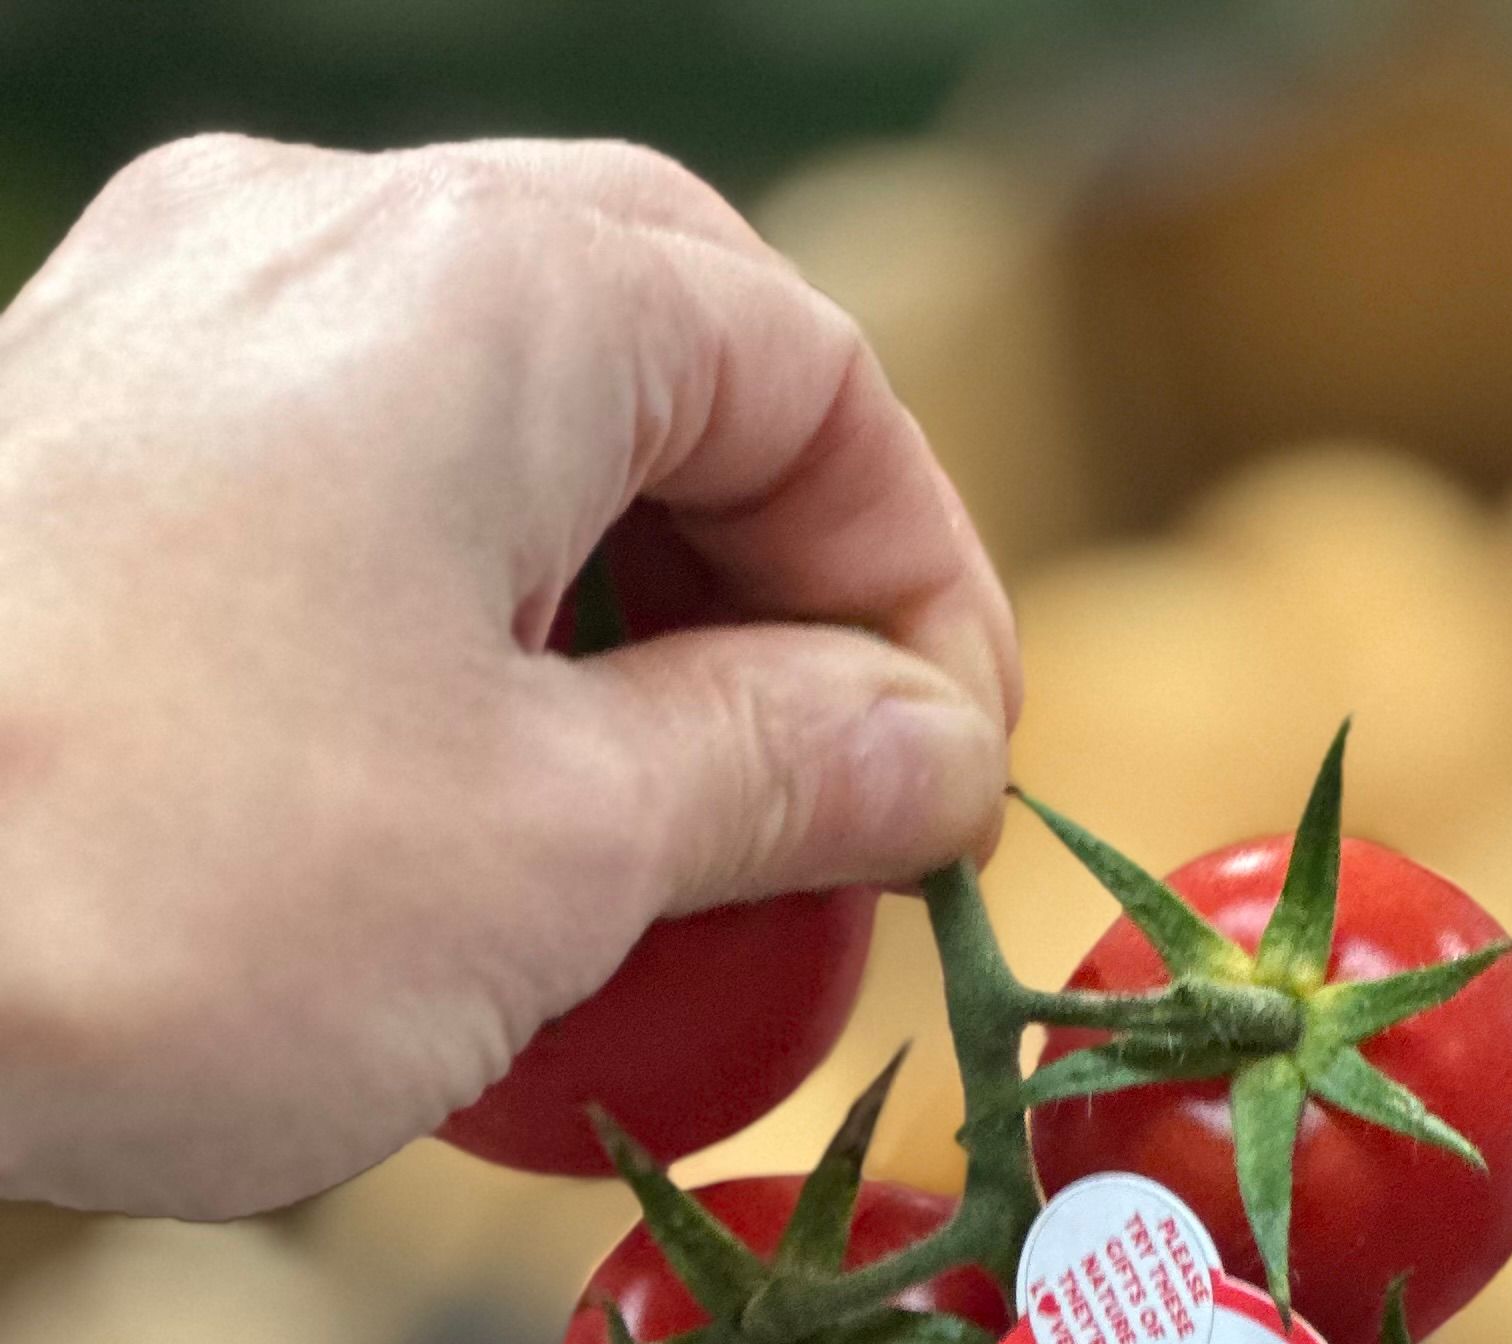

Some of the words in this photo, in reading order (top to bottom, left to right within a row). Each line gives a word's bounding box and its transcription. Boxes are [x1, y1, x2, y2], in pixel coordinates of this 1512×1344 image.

[1106, 1236, 1146, 1306] GIFTS
[1140, 1307, 1165, 1339] OF
[1125, 1210, 1156, 1260] TRY
[1150, 1260, 1195, 1340] THESE
[1158, 1215, 1209, 1307] PLEASE
